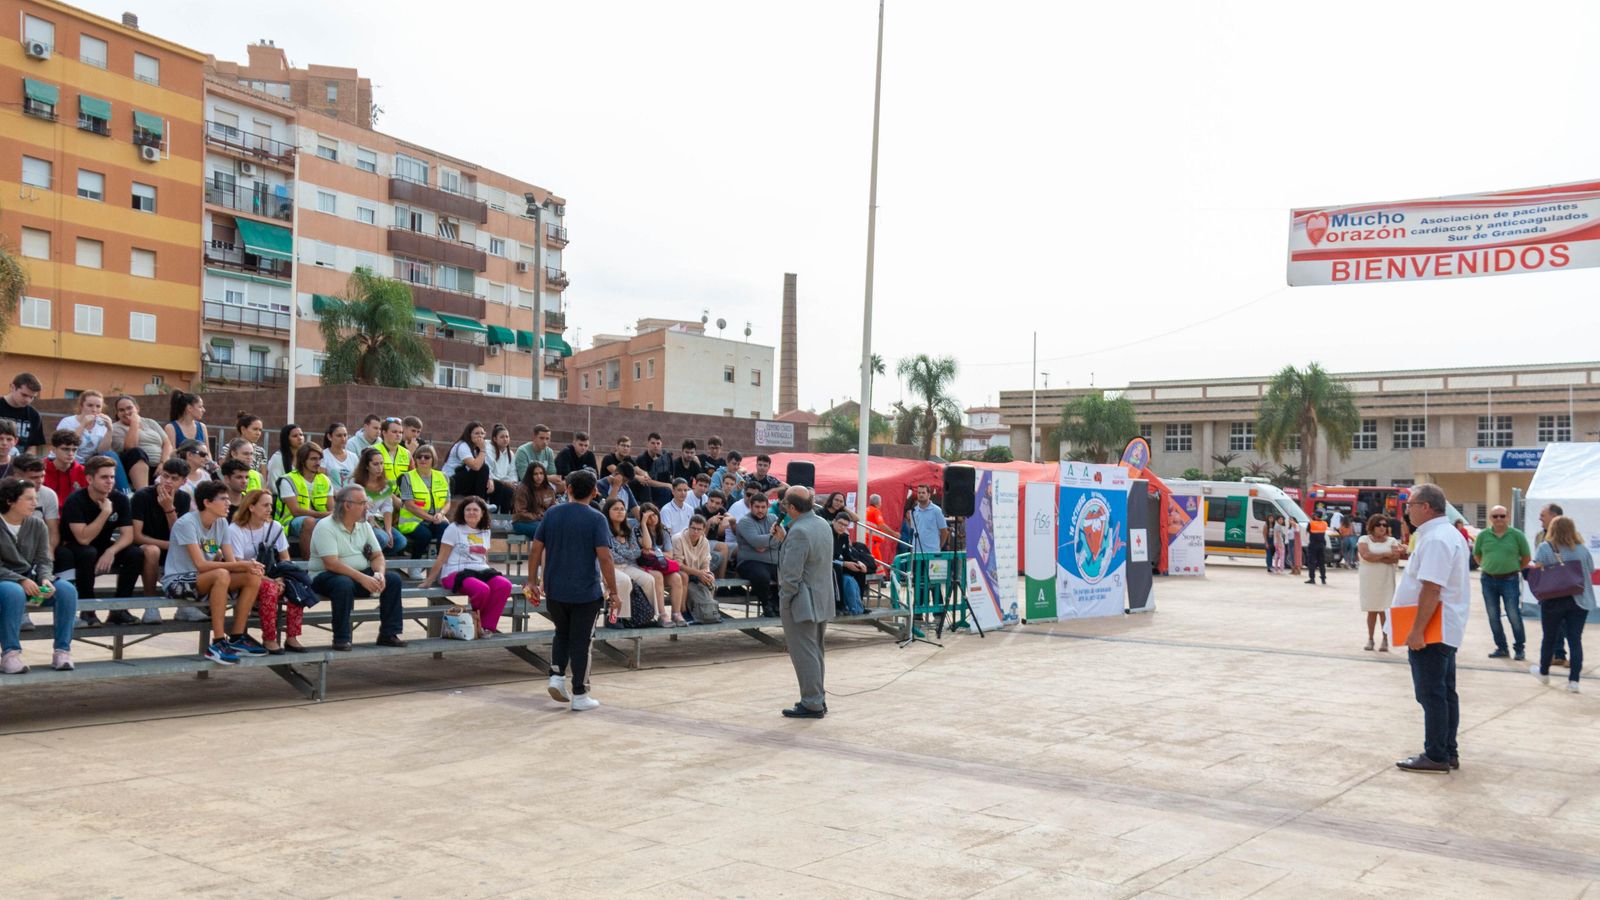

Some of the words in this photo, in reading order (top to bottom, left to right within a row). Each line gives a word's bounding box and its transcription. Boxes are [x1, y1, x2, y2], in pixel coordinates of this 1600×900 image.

[1331, 211, 1405, 227] Mucho
[1420, 213, 1489, 225] Asociación
[1493, 211, 1509, 219] de
[1513, 203, 1579, 217] pacientes
[1475, 223, 1484, 231] y
[1487, 212, 1589, 229] anticoagulados
[1326, 225, 1406, 242] orazón
[1447, 234, 1470, 242] Sur
[1472, 232, 1488, 240] de
[1491, 226, 1547, 238] Granada
[1331, 244, 1570, 282] BIENVENIDOS
